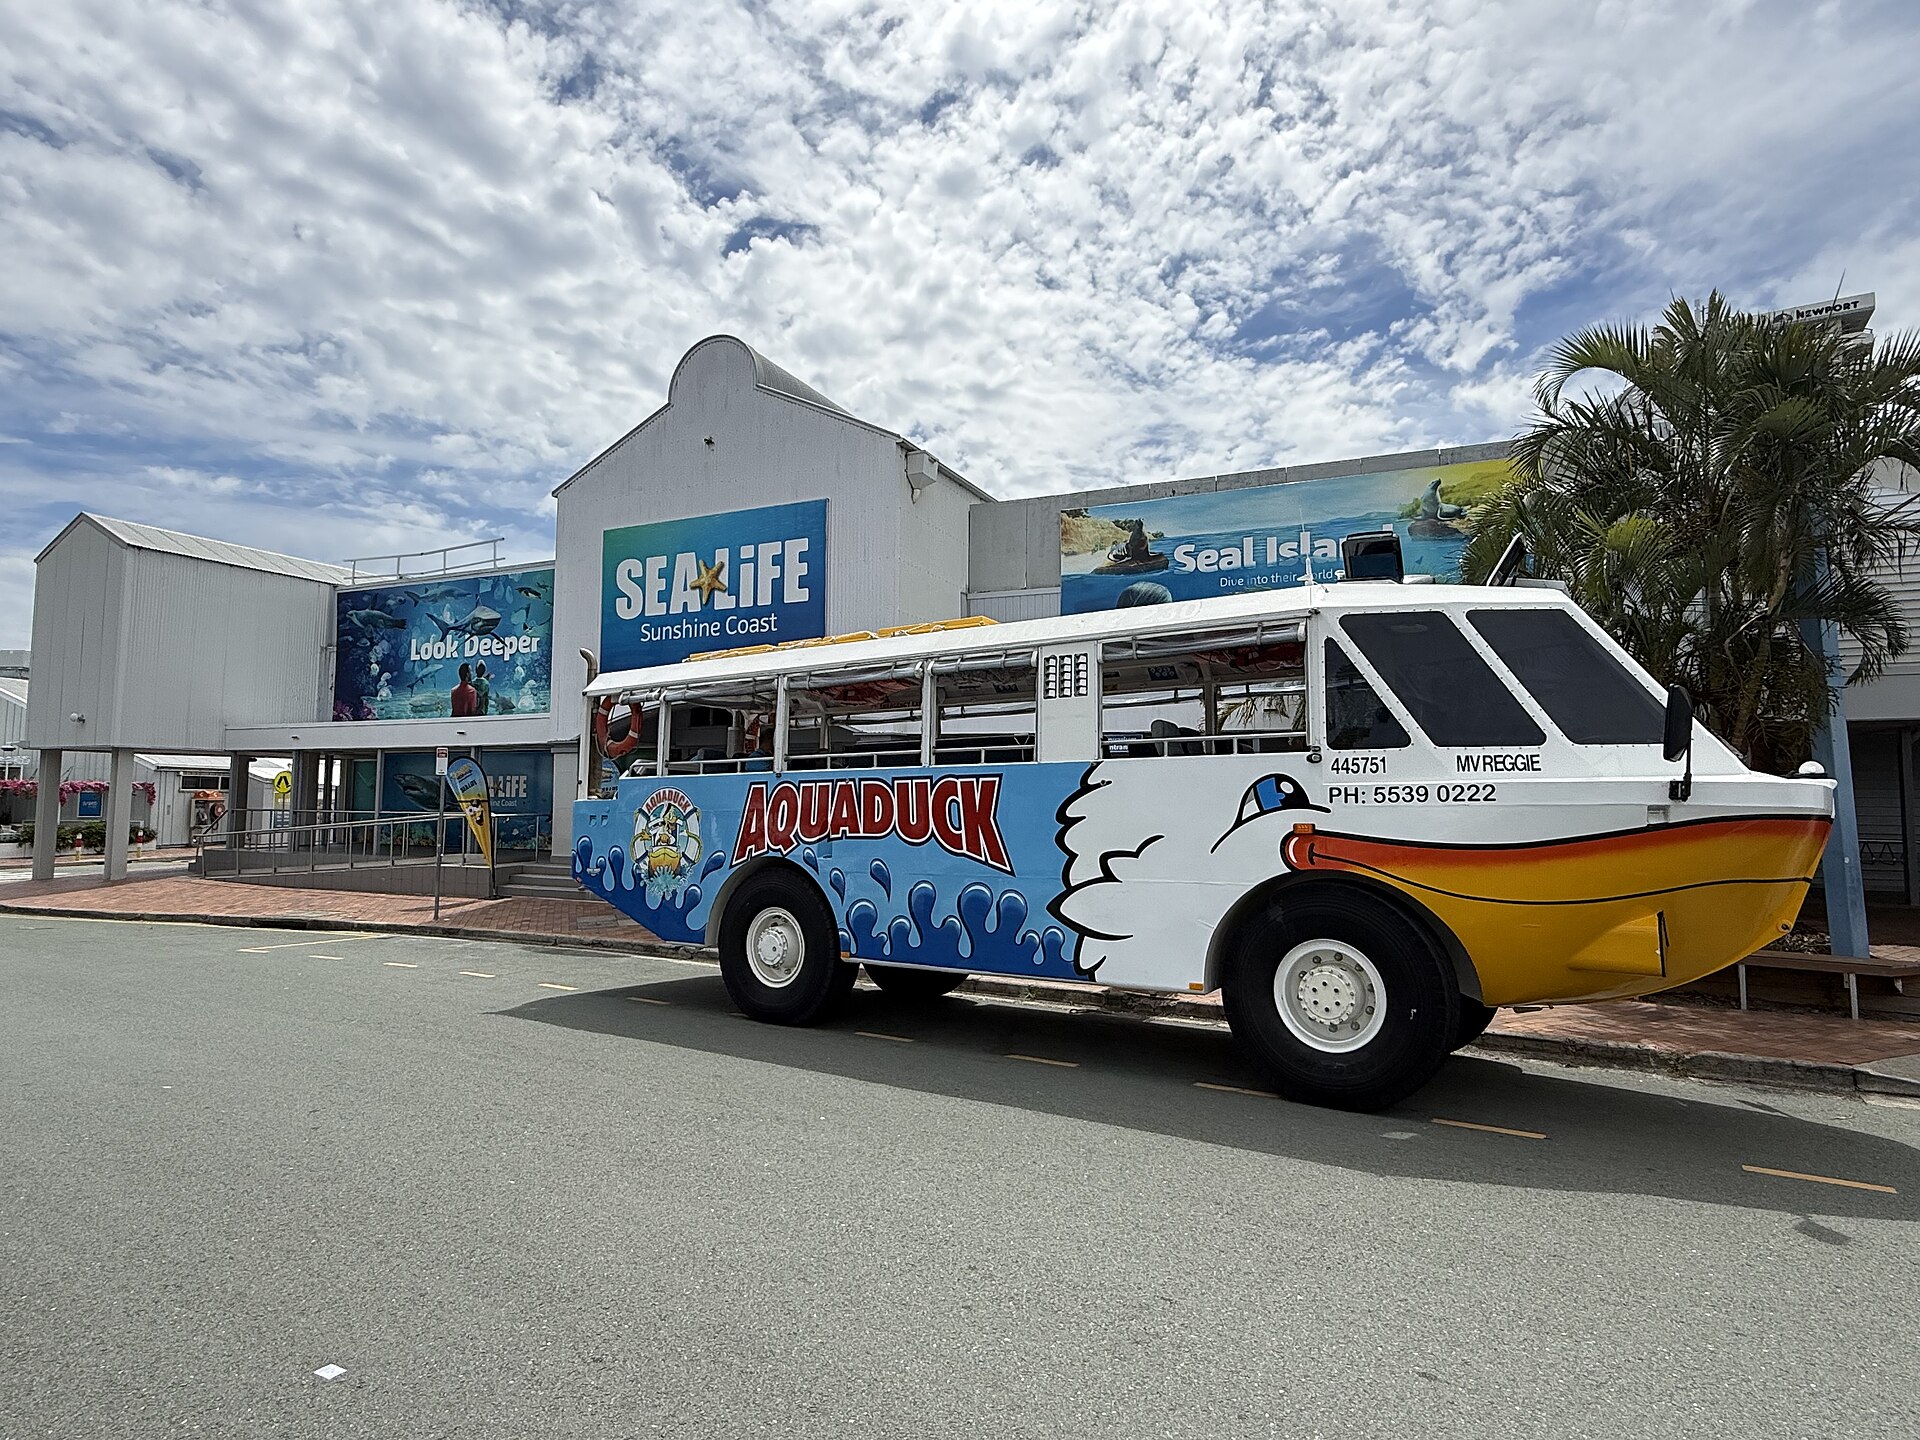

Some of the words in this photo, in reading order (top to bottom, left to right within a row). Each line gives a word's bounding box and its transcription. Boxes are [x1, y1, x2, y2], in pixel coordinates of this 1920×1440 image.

[1174, 536, 1257, 573] Seal
[1219, 577, 1244, 587] Dive
[1247, 575, 1268, 586] into
[1270, 572, 1297, 583] their
[640, 619, 721, 642] Sunshine
[726, 613, 778, 634] Coast
[410, 635, 459, 660] Look
[464, 634, 540, 661] Deeper
[1330, 756, 1387, 774] 445751
[645, 788, 692, 814] AQUADUCK
[1329, 786, 1366, 804] PH:
[1373, 785, 1429, 803] 5539
[1436, 784, 1497, 802] 0222
[730, 776, 1014, 873] AQUADUCK
